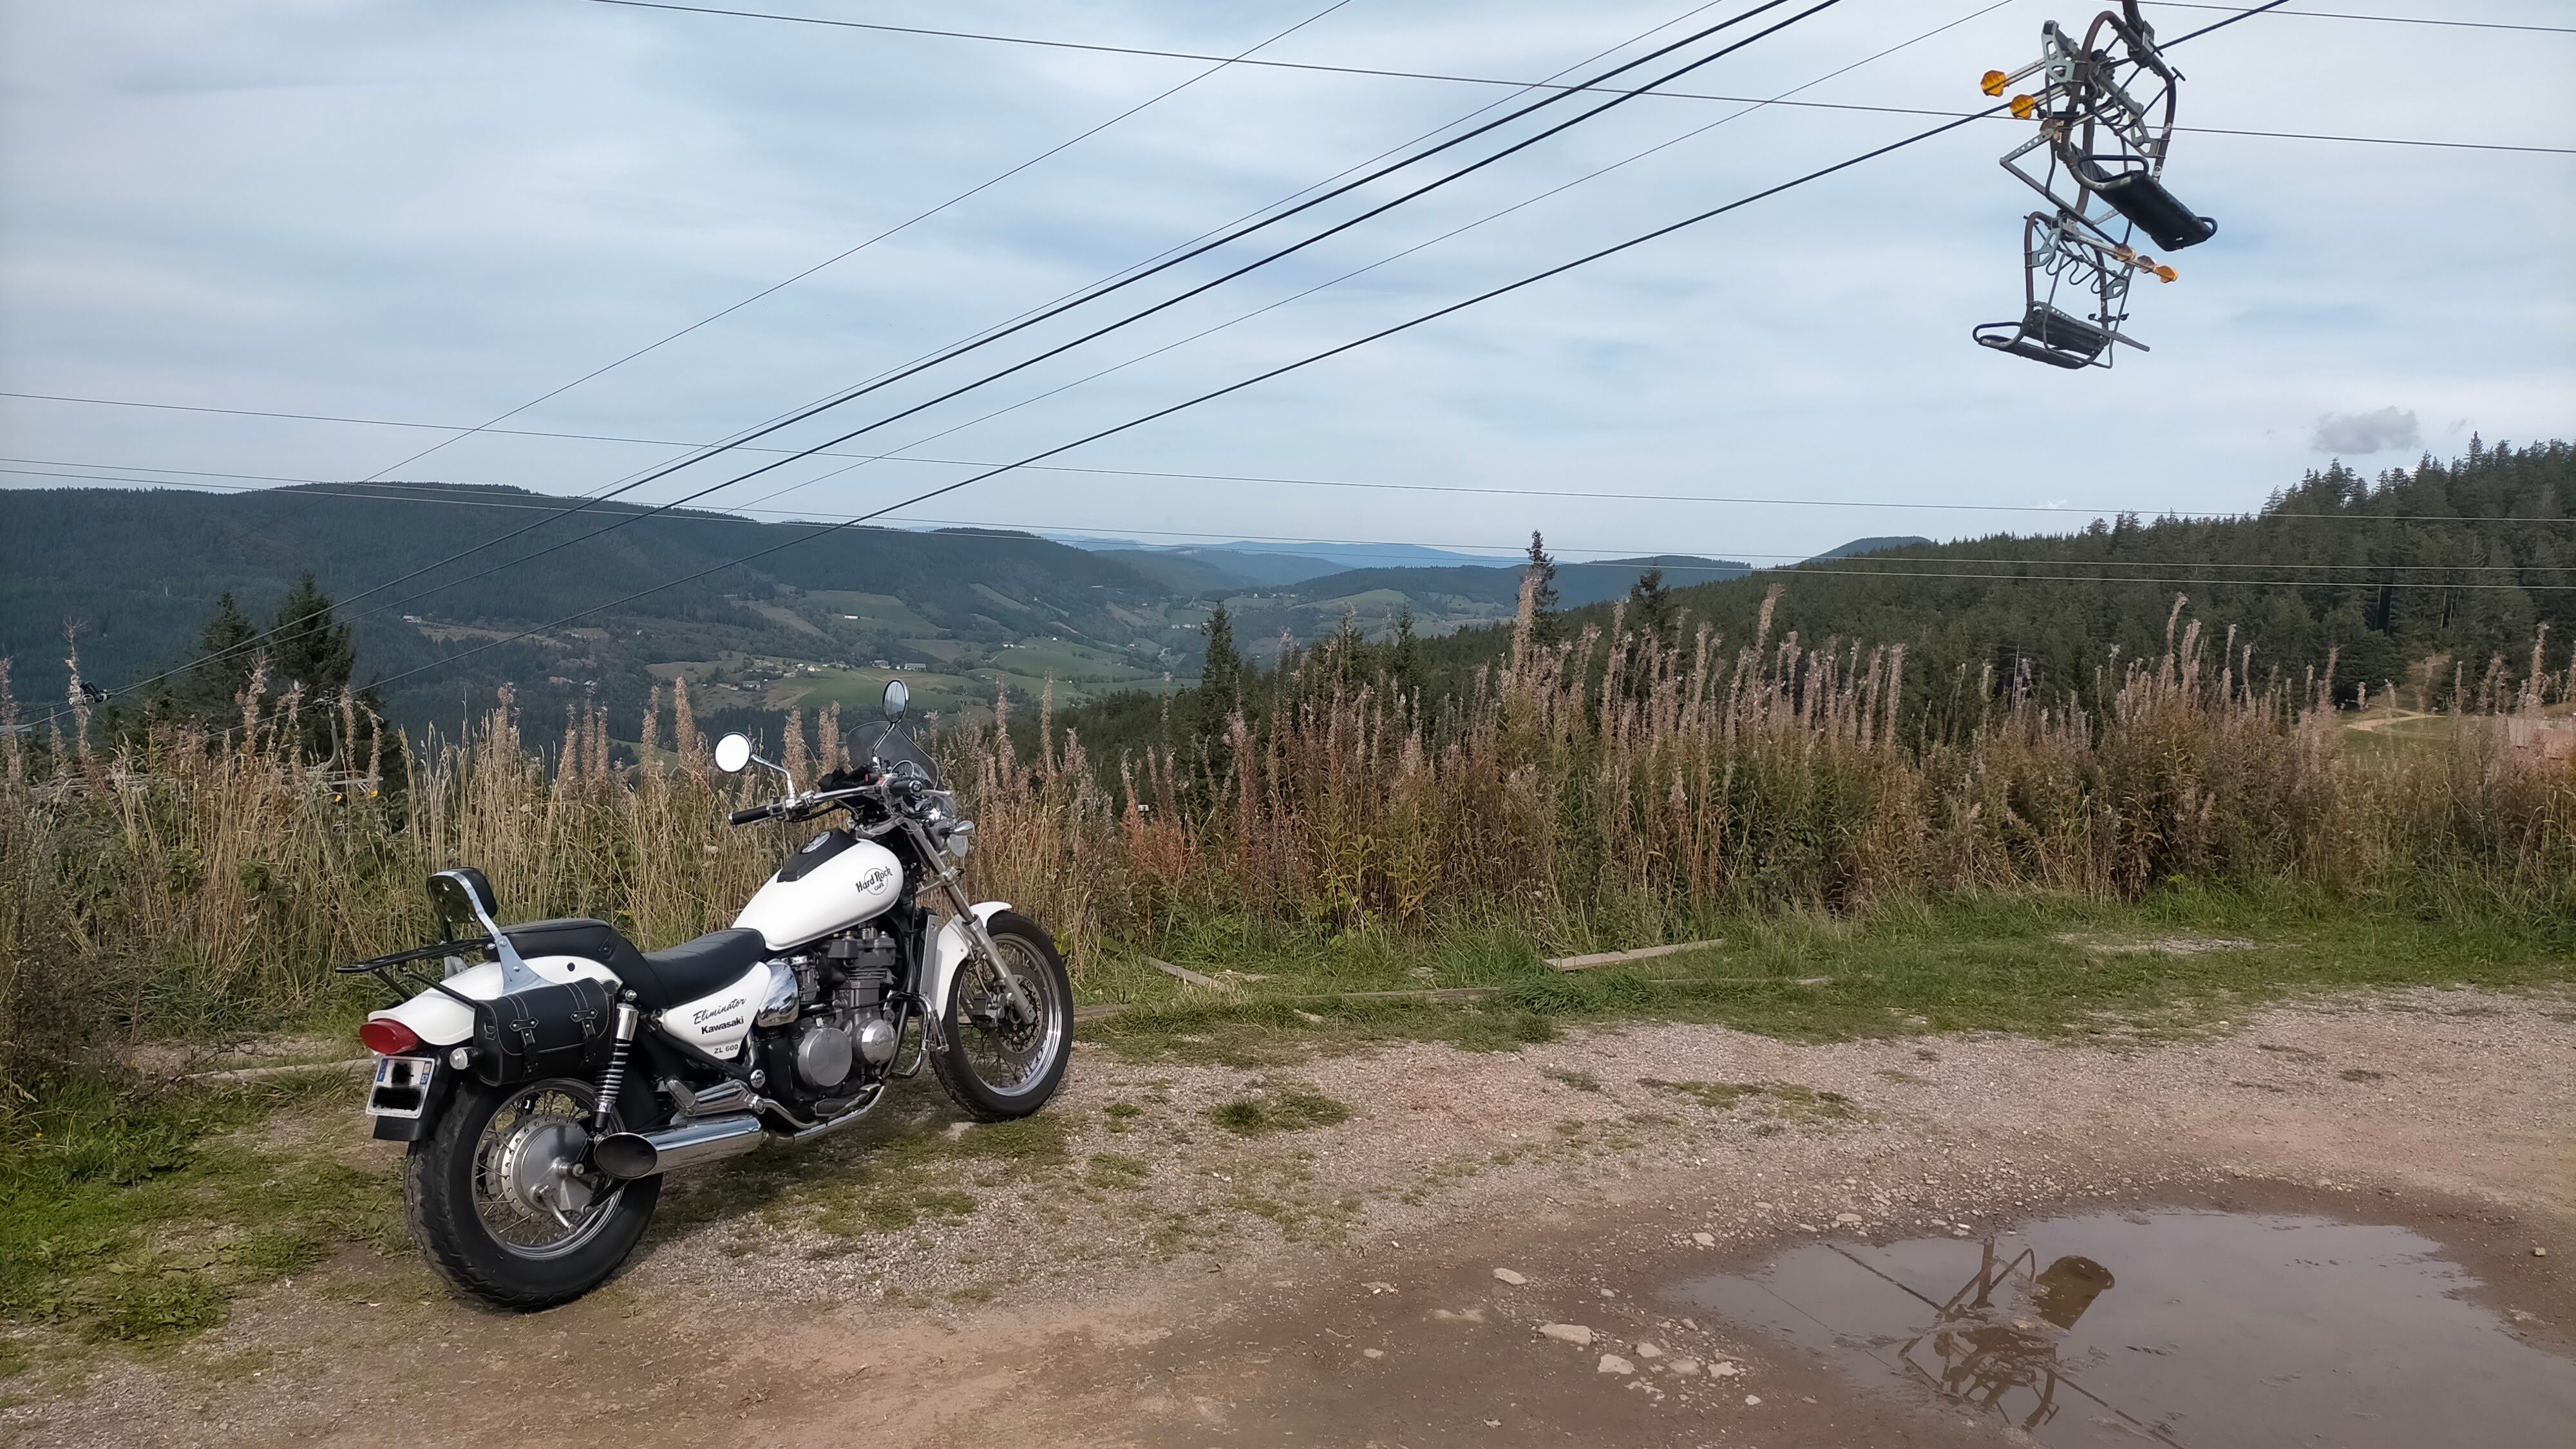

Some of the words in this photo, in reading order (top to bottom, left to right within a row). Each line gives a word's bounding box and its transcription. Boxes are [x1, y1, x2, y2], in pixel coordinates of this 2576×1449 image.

[855, 875, 875, 893] Hard
[874, 866, 893, 882] Rock
[875, 882, 884, 891] CAFE
[693, 998, 747, 1025] Eliminator
[701, 1016, 744, 1035] Kawasaki
[421, 1074, 428, 1083] 57
